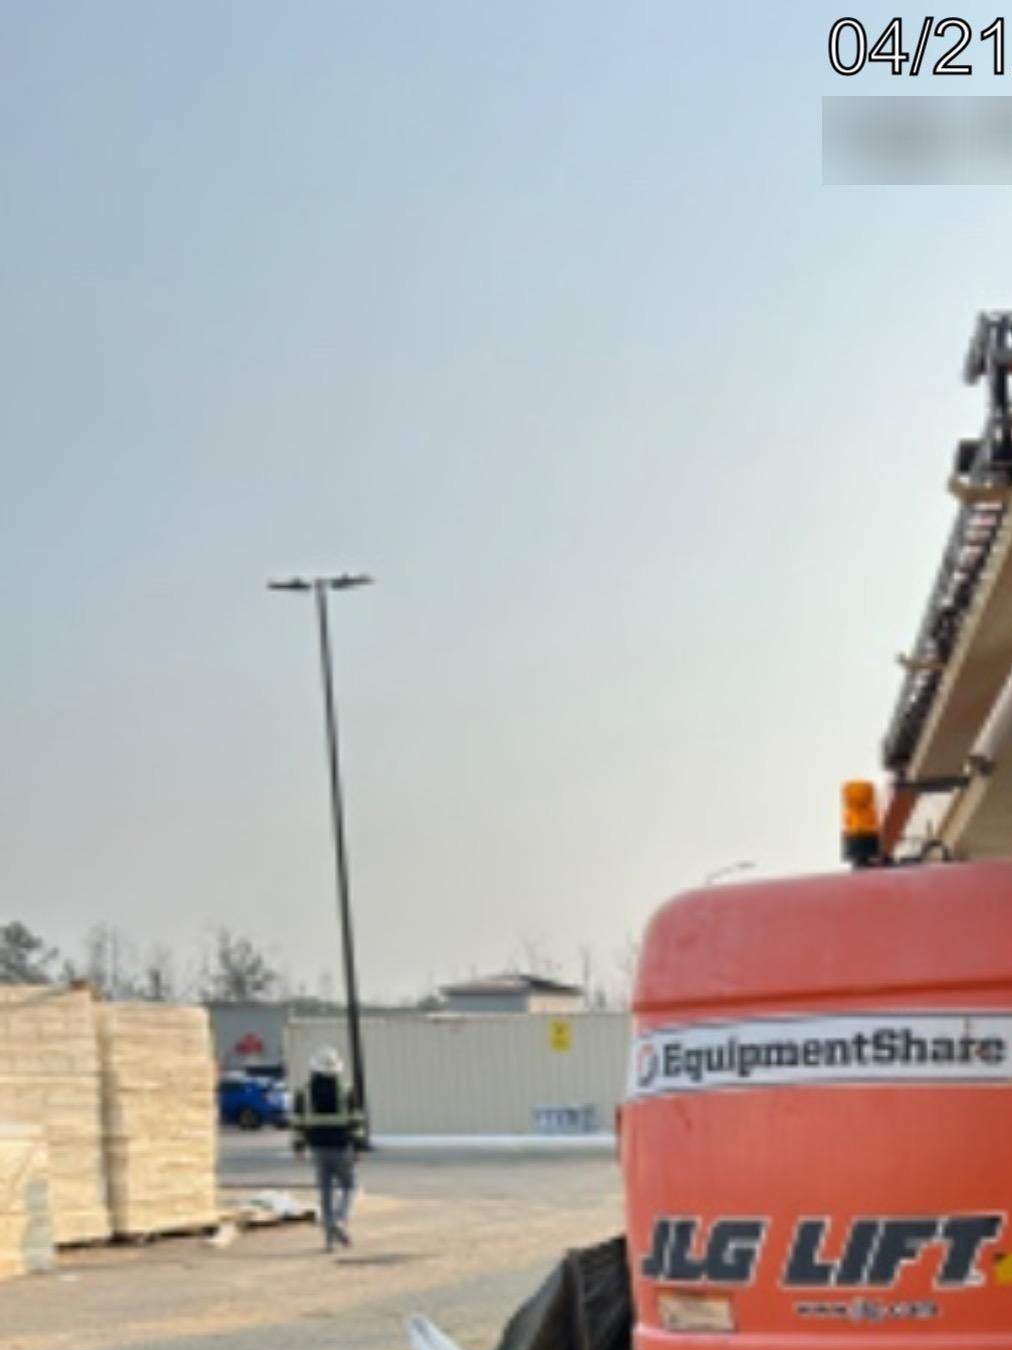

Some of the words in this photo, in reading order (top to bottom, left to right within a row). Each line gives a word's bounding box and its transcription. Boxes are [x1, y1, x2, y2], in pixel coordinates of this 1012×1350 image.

[662, 1028, 1008, 1081] EquipmentShare
[641, 1214, 771, 1286] JLG
[779, 1210, 1008, 1290] LIFT
